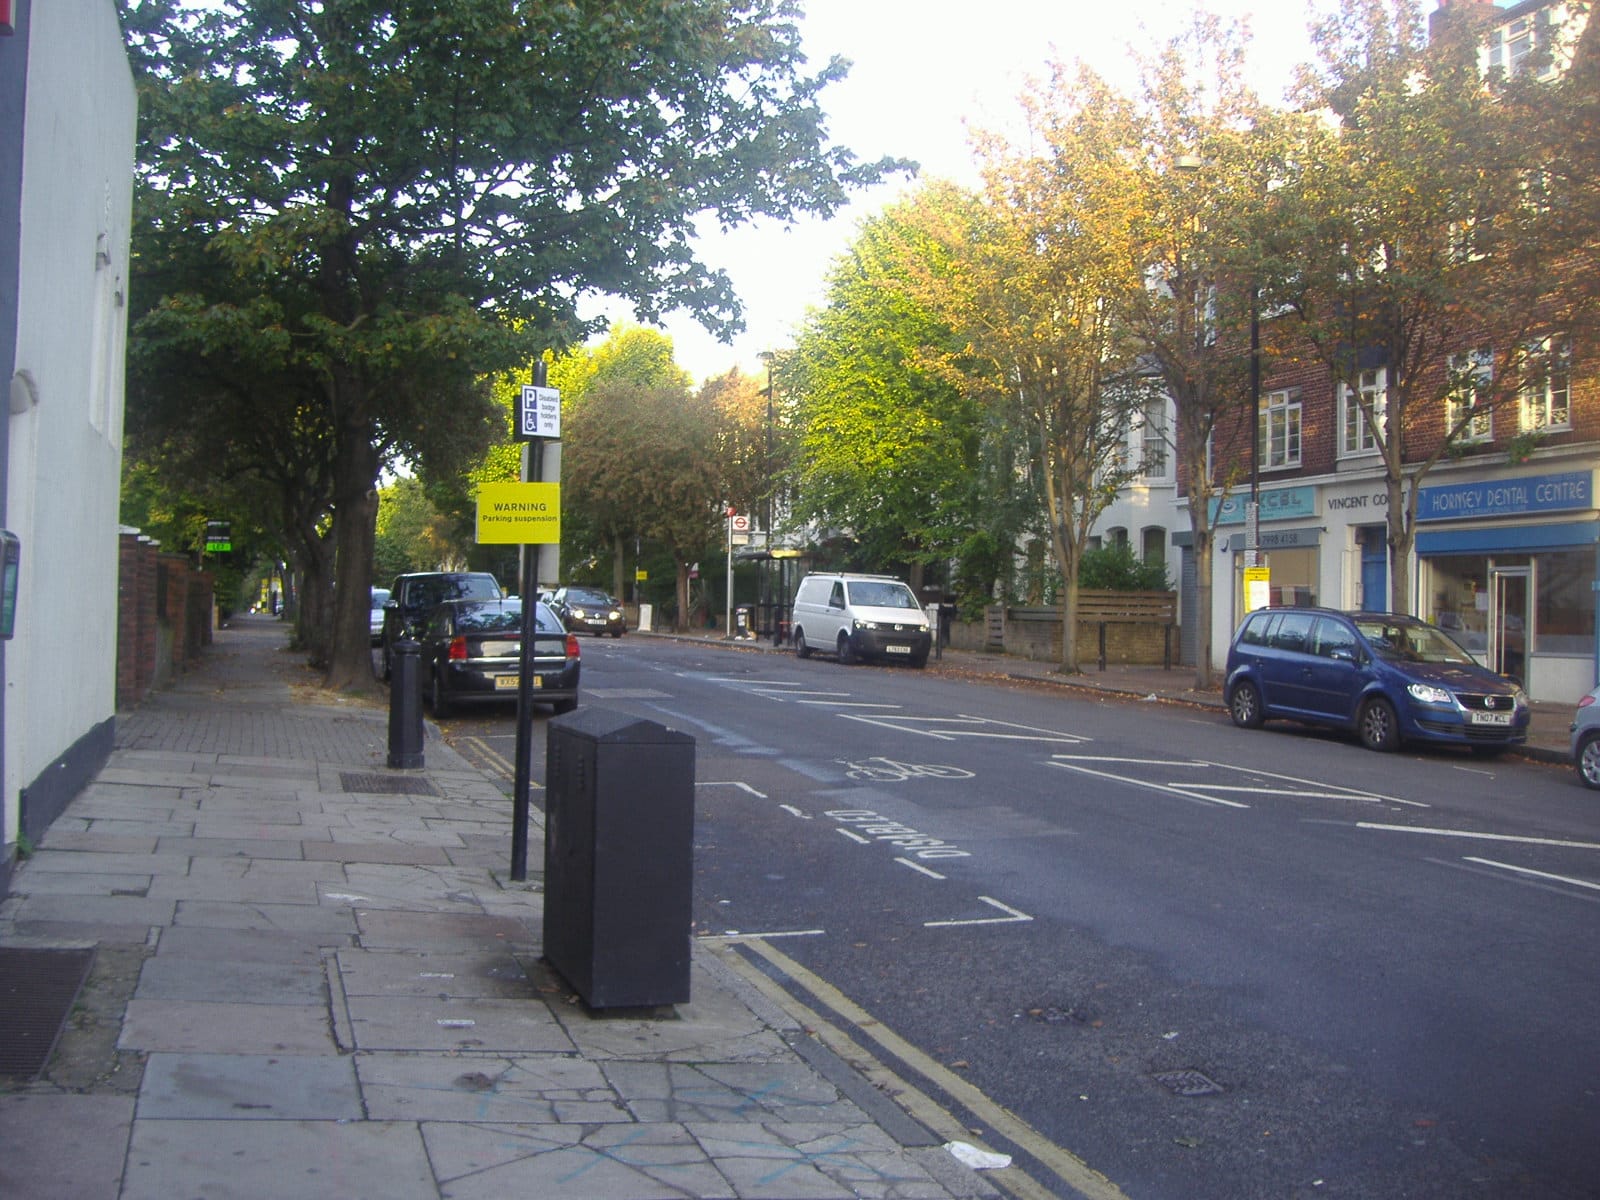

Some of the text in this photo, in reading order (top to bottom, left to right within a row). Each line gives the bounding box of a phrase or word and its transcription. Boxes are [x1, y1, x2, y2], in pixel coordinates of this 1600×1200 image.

[538, 393, 558, 402] Disabled
[541, 404, 555, 412] badge
[543, 422, 554, 430] only
[1432, 480, 1585, 511] HORNSEY DENTAL CENTRE
[1327, 491, 1406, 510] VINCENT COT
[493, 503, 547, 512] WARNING
[482, 515, 558, 523] Parking suspension
[824, 810, 971, 858] DISABLED
